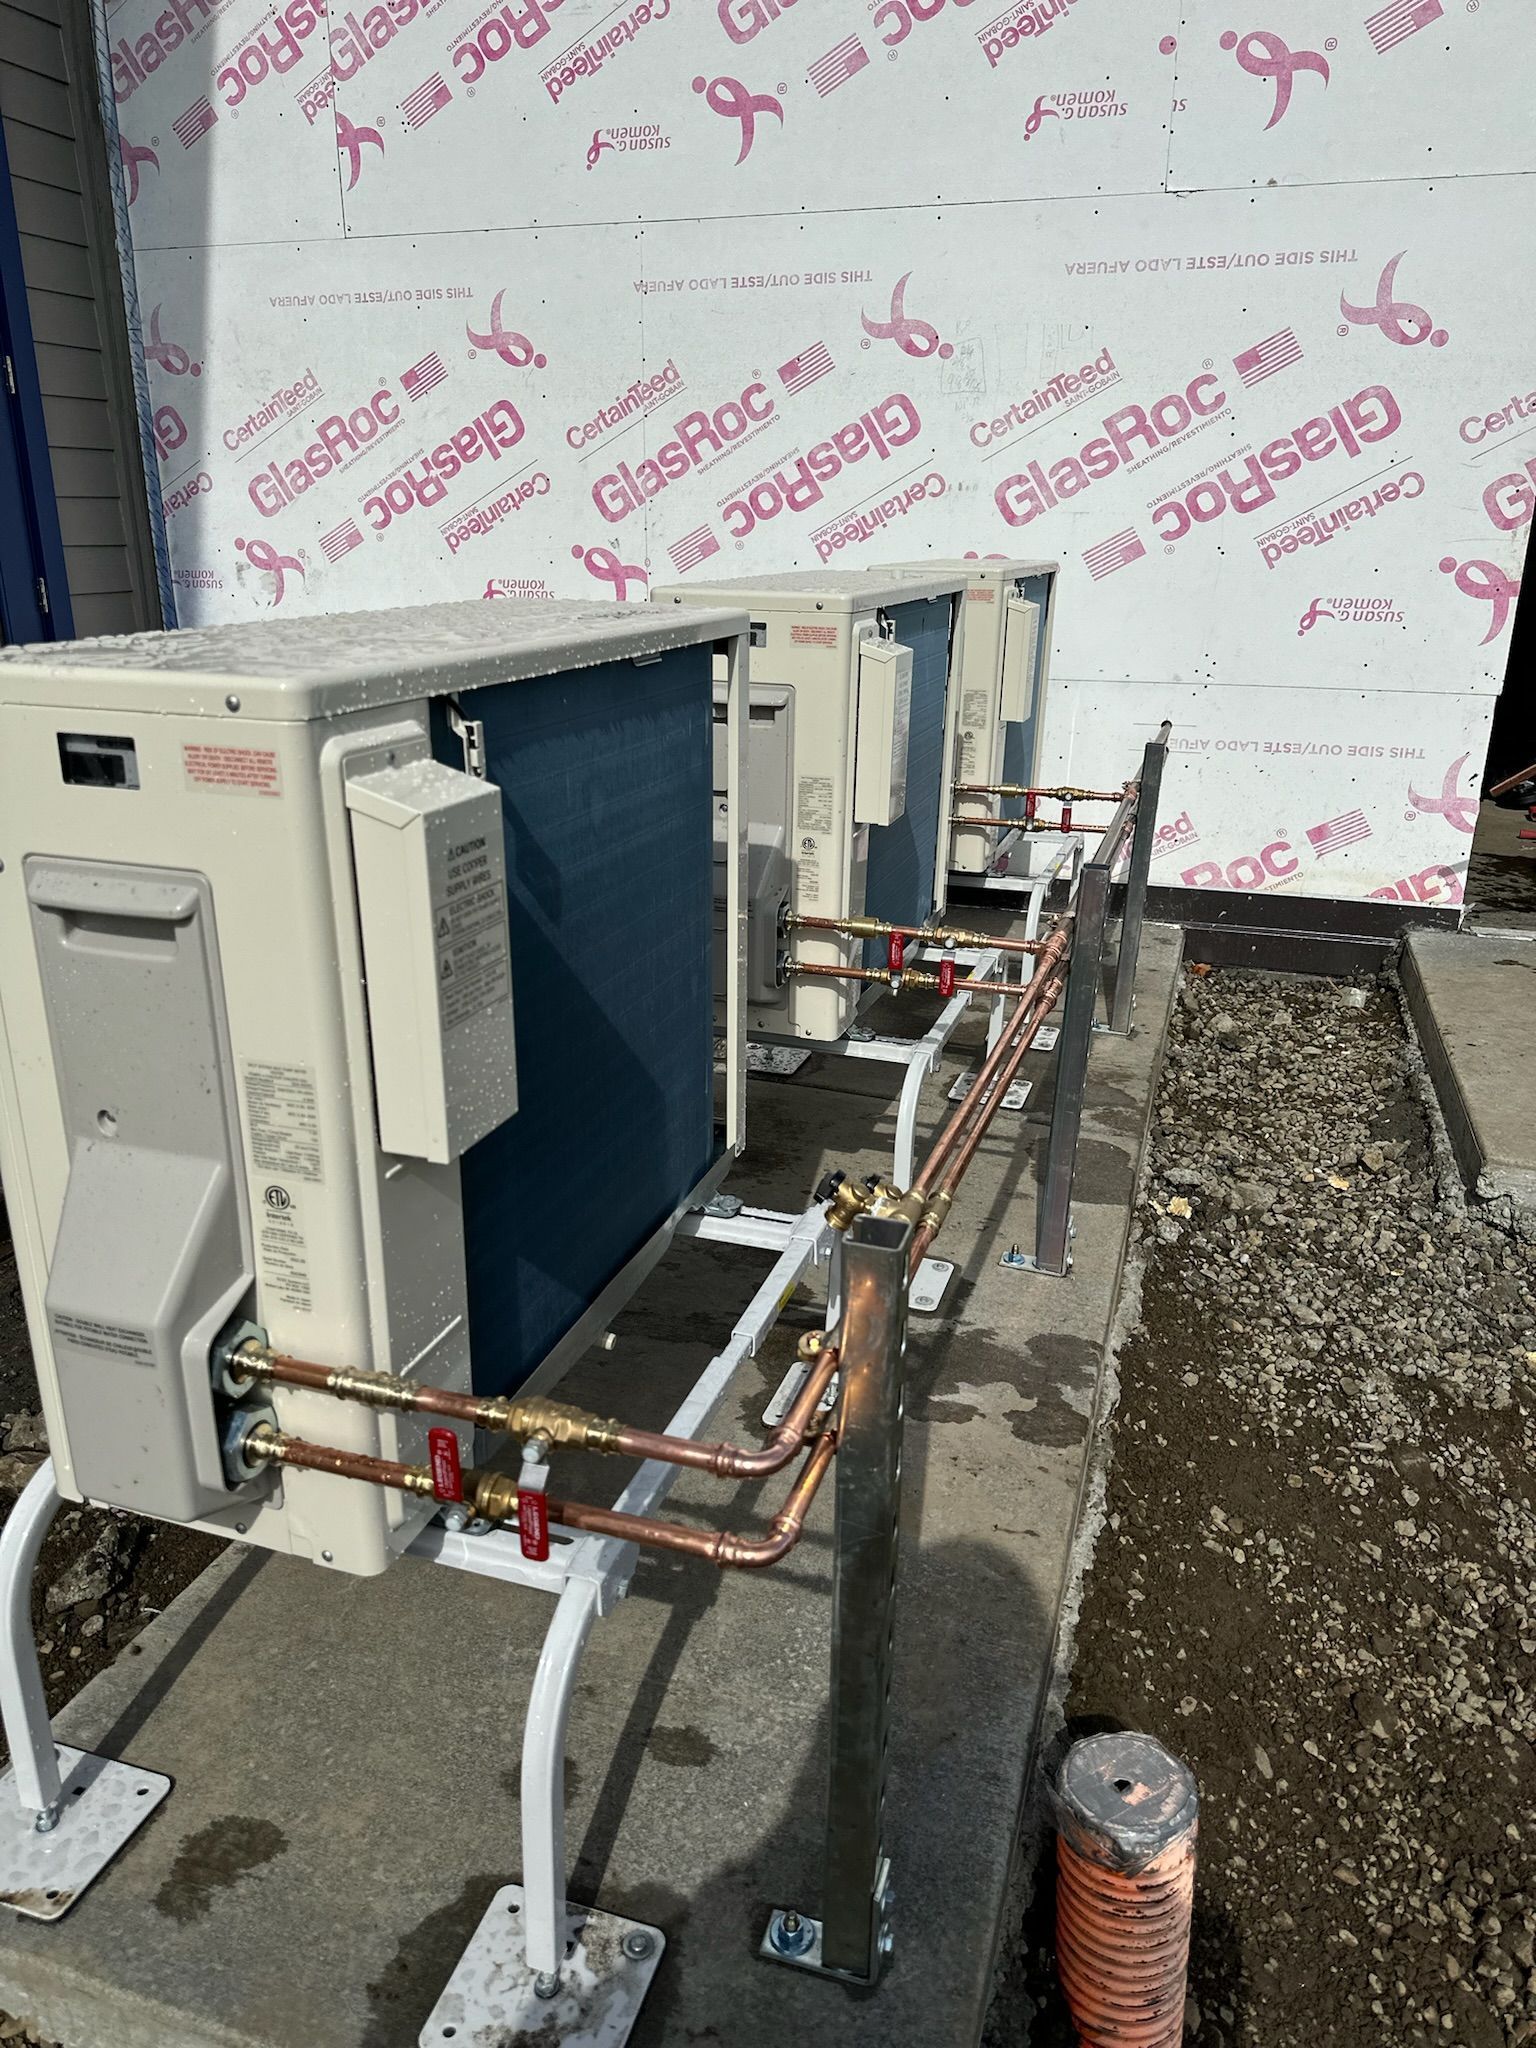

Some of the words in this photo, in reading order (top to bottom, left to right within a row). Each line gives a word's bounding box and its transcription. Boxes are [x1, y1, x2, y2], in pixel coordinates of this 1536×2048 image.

[329, 0, 432, 82] Glas
[545, 0, 671, 105] CertainTeed
[541, 41, 586, 83] SAINT-GOBAIN
[1064, 259, 1130, 276] AFUERA
[1134, 257, 1182, 273] LADO
[1186, 252, 1270, 271] OUT/ESTE
[1275, 251, 1315, 265] SIDE
[1320, 249, 1358, 264] THIS
[633, 279, 685, 293] AFUERA
[689, 277, 727, 290] LADO
[731, 273, 800, 289] OUT/ESTE
[804, 271, 836, 285] SIDE
[841, 269, 873, 283] THIS
[269, 295, 315, 307] AFUERA
[319, 293, 352, 305] LADO
[354, 290, 413, 304] OUT/ESTE
[416, 288, 443, 301] SIDE
[446, 287, 474, 299] THIS
[286, 386, 323, 418] SAINT-GOBAIN
[566, 358, 681, 449] CertainTeed
[969, 347, 1116, 448] CertainTeed
[1064, 370, 1121, 408] SAINT-GOBAIN
[222, 367, 319, 451] CertainTeed
[247, 389, 400, 518] GlasRoc
[339, 418, 406, 474] SHEATHING/REVESTIMIENTO
[591, 382, 775, 523] GlasRoc
[697, 414, 781, 475] SHEATHING/REVESTIMIENTO
[993, 373, 1227, 528] GlasRoc
[1127, 407, 1232, 475] SHEATHING/REVESTIMIENTO
[358, 447, 425, 503] SHEATHING/REVESTIMIENTO
[363, 399, 525, 531] GlasRoc
[716, 446, 800, 508] SHEATHING/REVESTIMIENTO
[722, 393, 922, 538] GlasRoc
[1146, 443, 1253, 509] SHEATHING/REVESTIMIENTO
[1152, 384, 1402, 542] GlasRoc
[440, 506, 479, 536] SAINT-GOBAIN
[445, 471, 551, 555] CertainTeed
[811, 510, 858, 544] SAINT-GOBAIN
[815, 472, 947, 565] CertainTeed
[1260, 471, 1425, 570] CertainTeed
[1256, 512, 1316, 548] SAINT-GOBAIN
[1215, 740, 1259, 752] LADO
[1263, 741, 1343, 756] OUT/ESTE
[1347, 745, 1384, 758] SIDE
[1393, 746, 1426, 760] THIS
[455, 837, 486, 857] CAUTION
[462, 854, 488, 874] COPPER
[446, 879, 470, 897] SUPPLY
